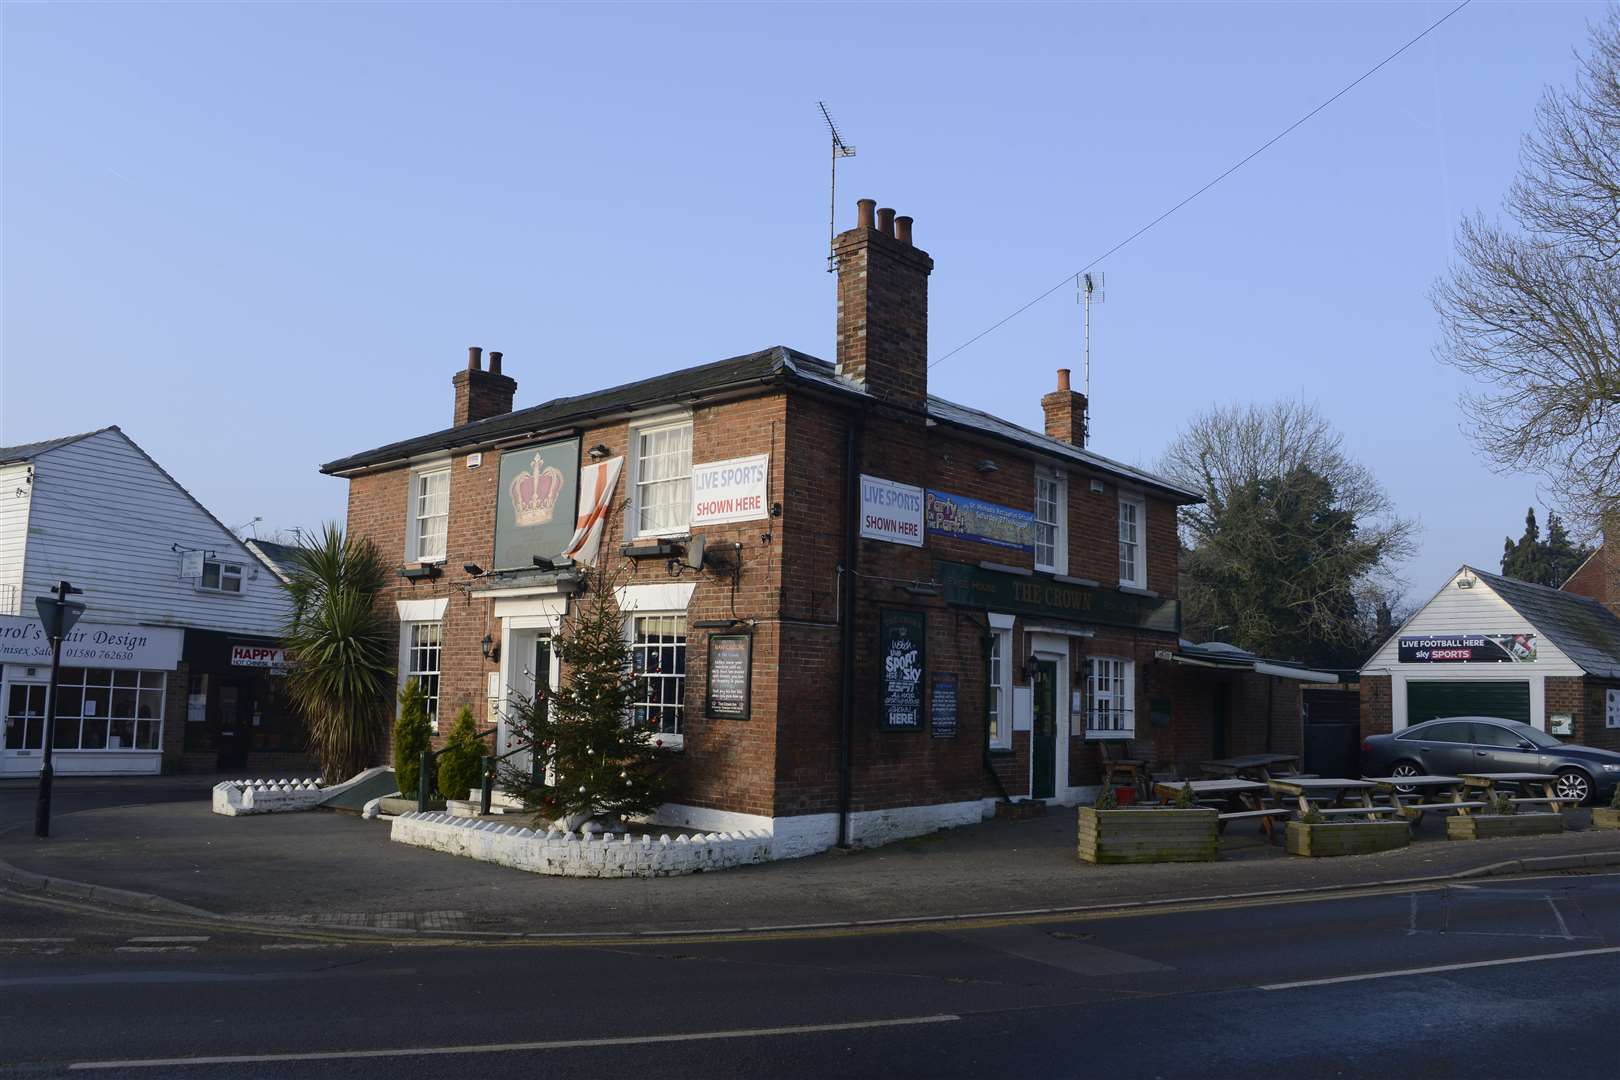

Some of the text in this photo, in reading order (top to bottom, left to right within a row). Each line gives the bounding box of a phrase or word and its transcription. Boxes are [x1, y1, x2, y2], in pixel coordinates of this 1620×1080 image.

[696, 464, 764, 490] LIVE SPORTS
[696, 495, 761, 516] SHOWN HERE
[864, 484, 920, 513] LIVE SPORTS
[865, 515, 897, 533] SHOWN
[898, 520, 918, 537] HERE
[1014, 582, 1093, 610] THE CROWN
[57, 628, 88, 643] air
[93, 630, 148, 651] Design
[1401, 639, 1485, 648] LIVE FOOTBALL HERE
[31, 645, 56, 657] Salo
[66, 648, 96, 658] 01580
[98, 650, 134, 661] 762630
[233, 648, 278, 661] HAPPY
[885, 650, 918, 673] SPORT
[1415, 649, 1470, 660] sky SPORTS
